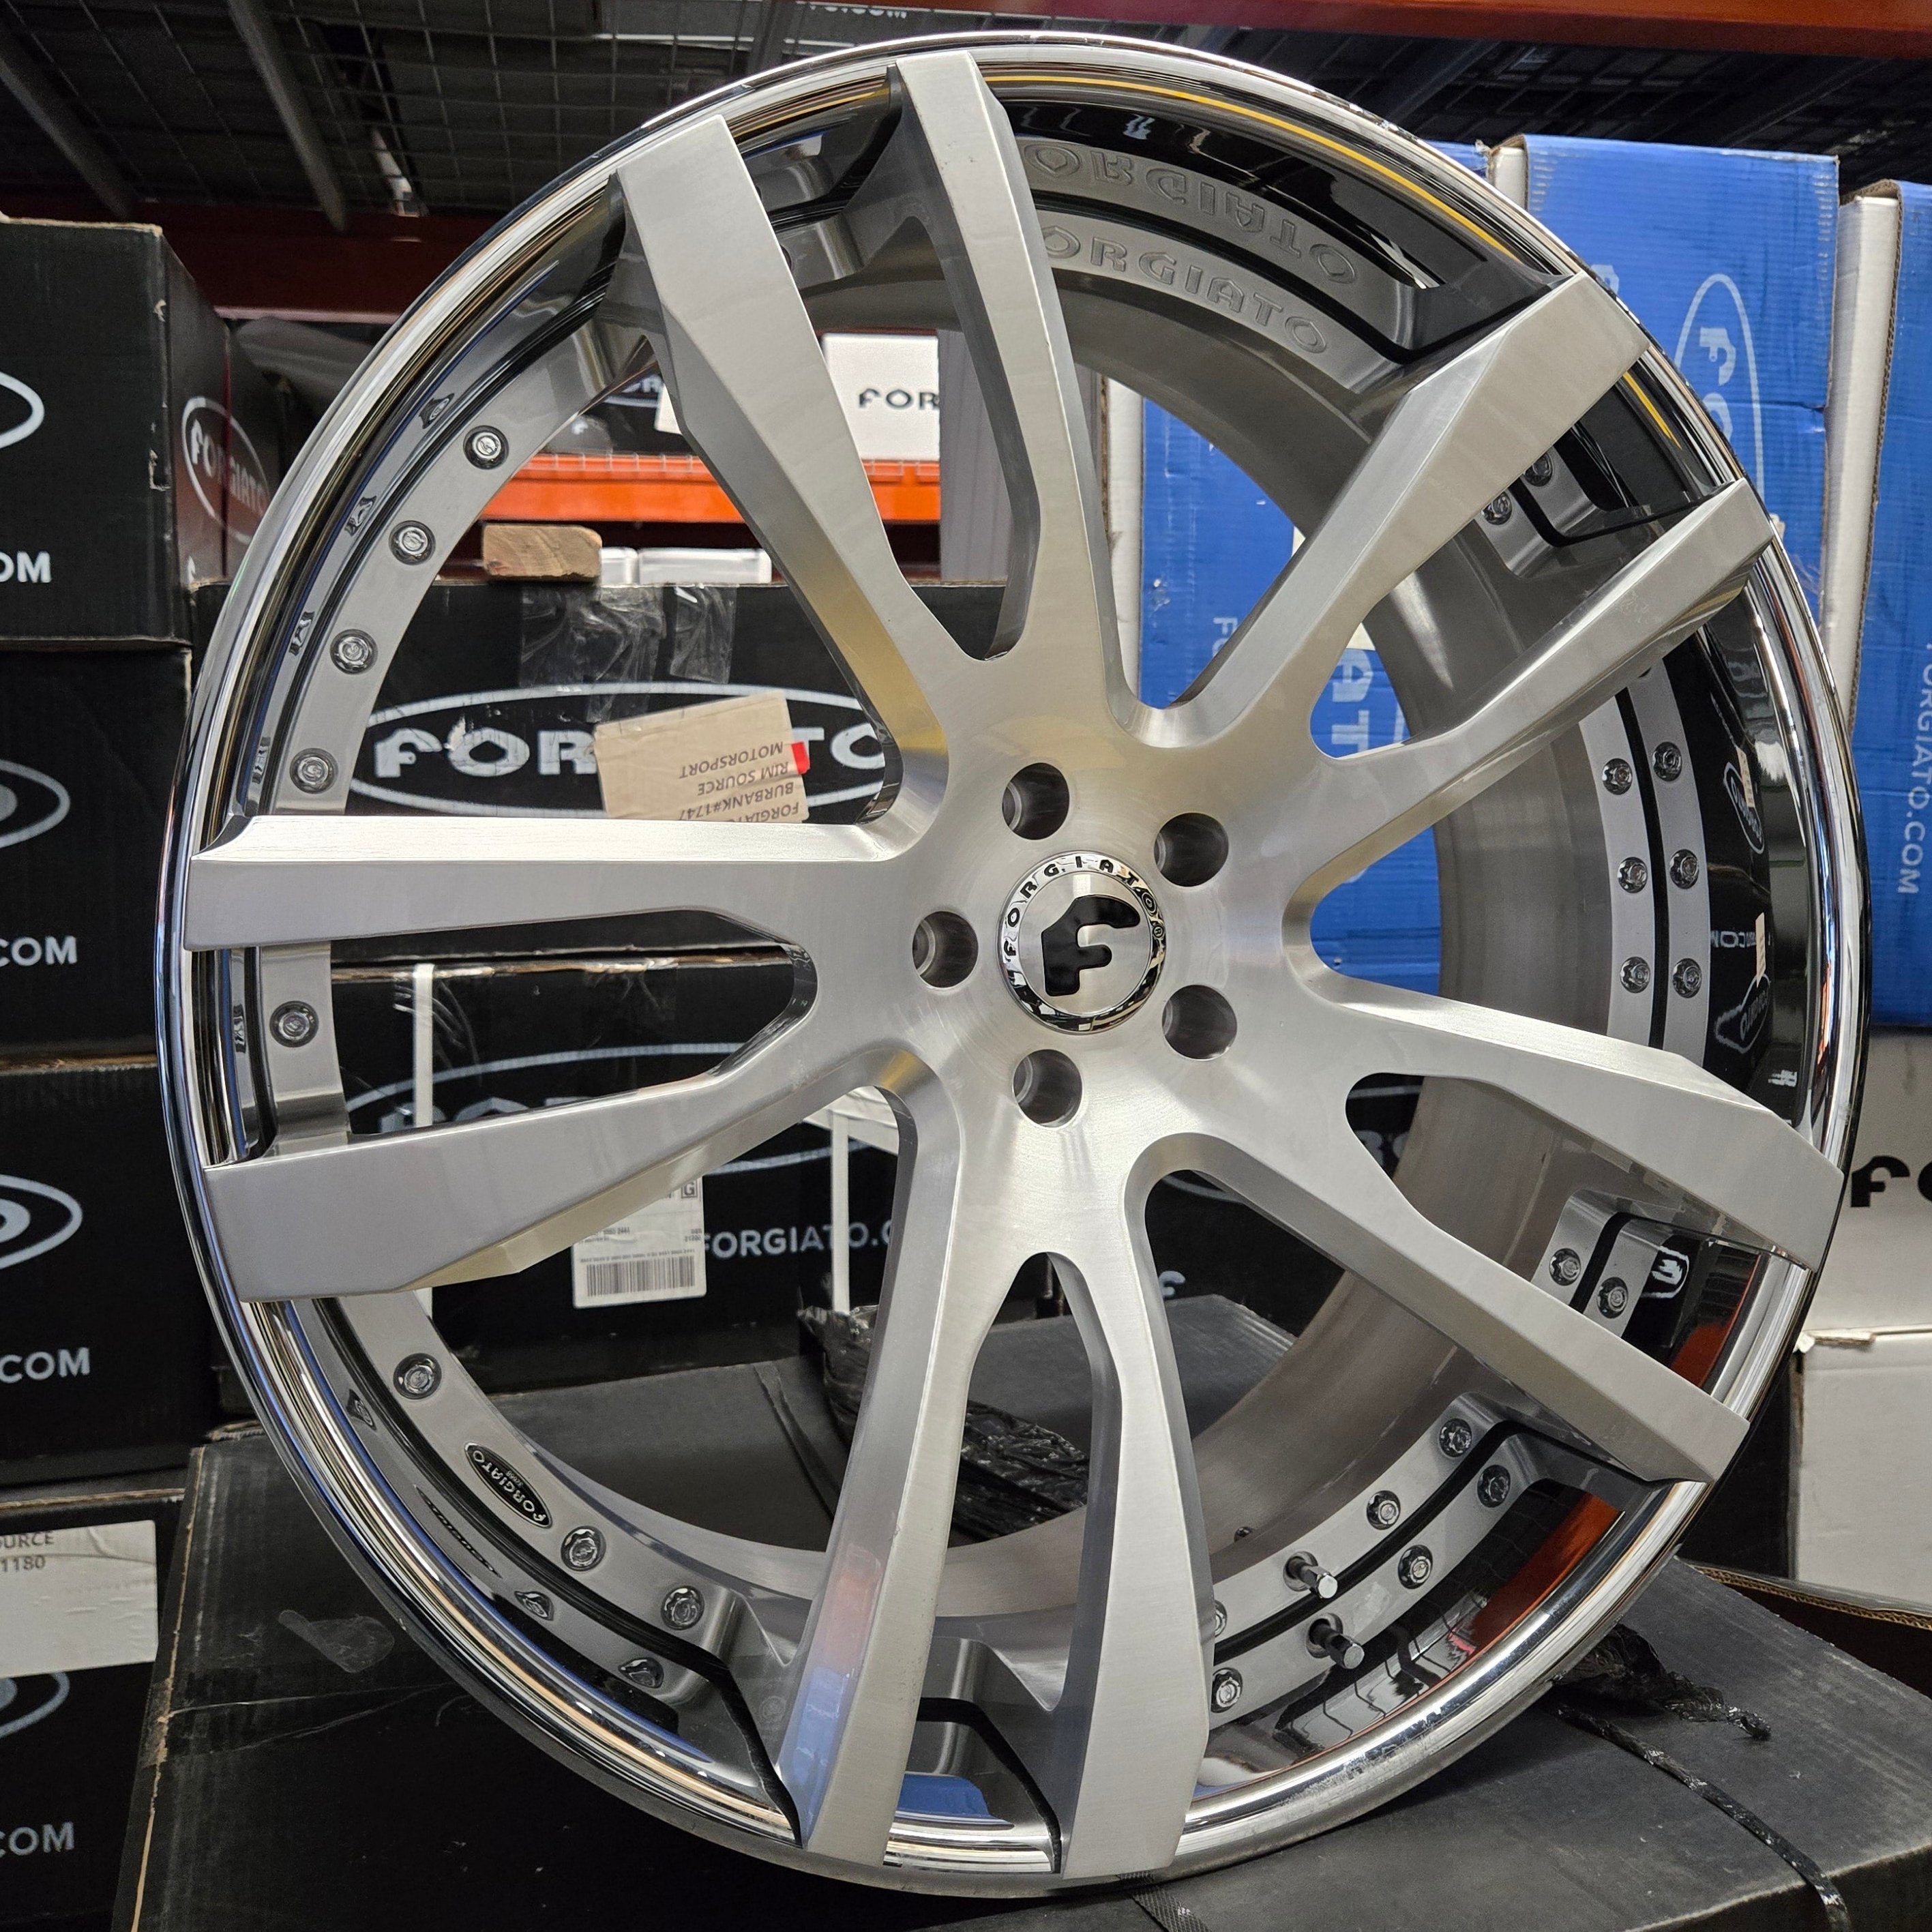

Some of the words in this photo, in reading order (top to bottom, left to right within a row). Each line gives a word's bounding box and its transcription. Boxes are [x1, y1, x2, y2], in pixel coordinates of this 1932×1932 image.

[679, 741, 784, 779] MOTORSPORT
[760, 761, 789, 779] RIM
[698, 769, 756, 796] SOURCE
[678, 782, 794, 821] BURBANK#1747
[728, 801, 799, 822] FORGIA
[1004, 855, 1158, 957] FORGIATO
[473, 1450, 546, 1521] FORGIATO
[0, 1530, 55, 1549] URCE
[0, 1821, 75, 1858] OM
